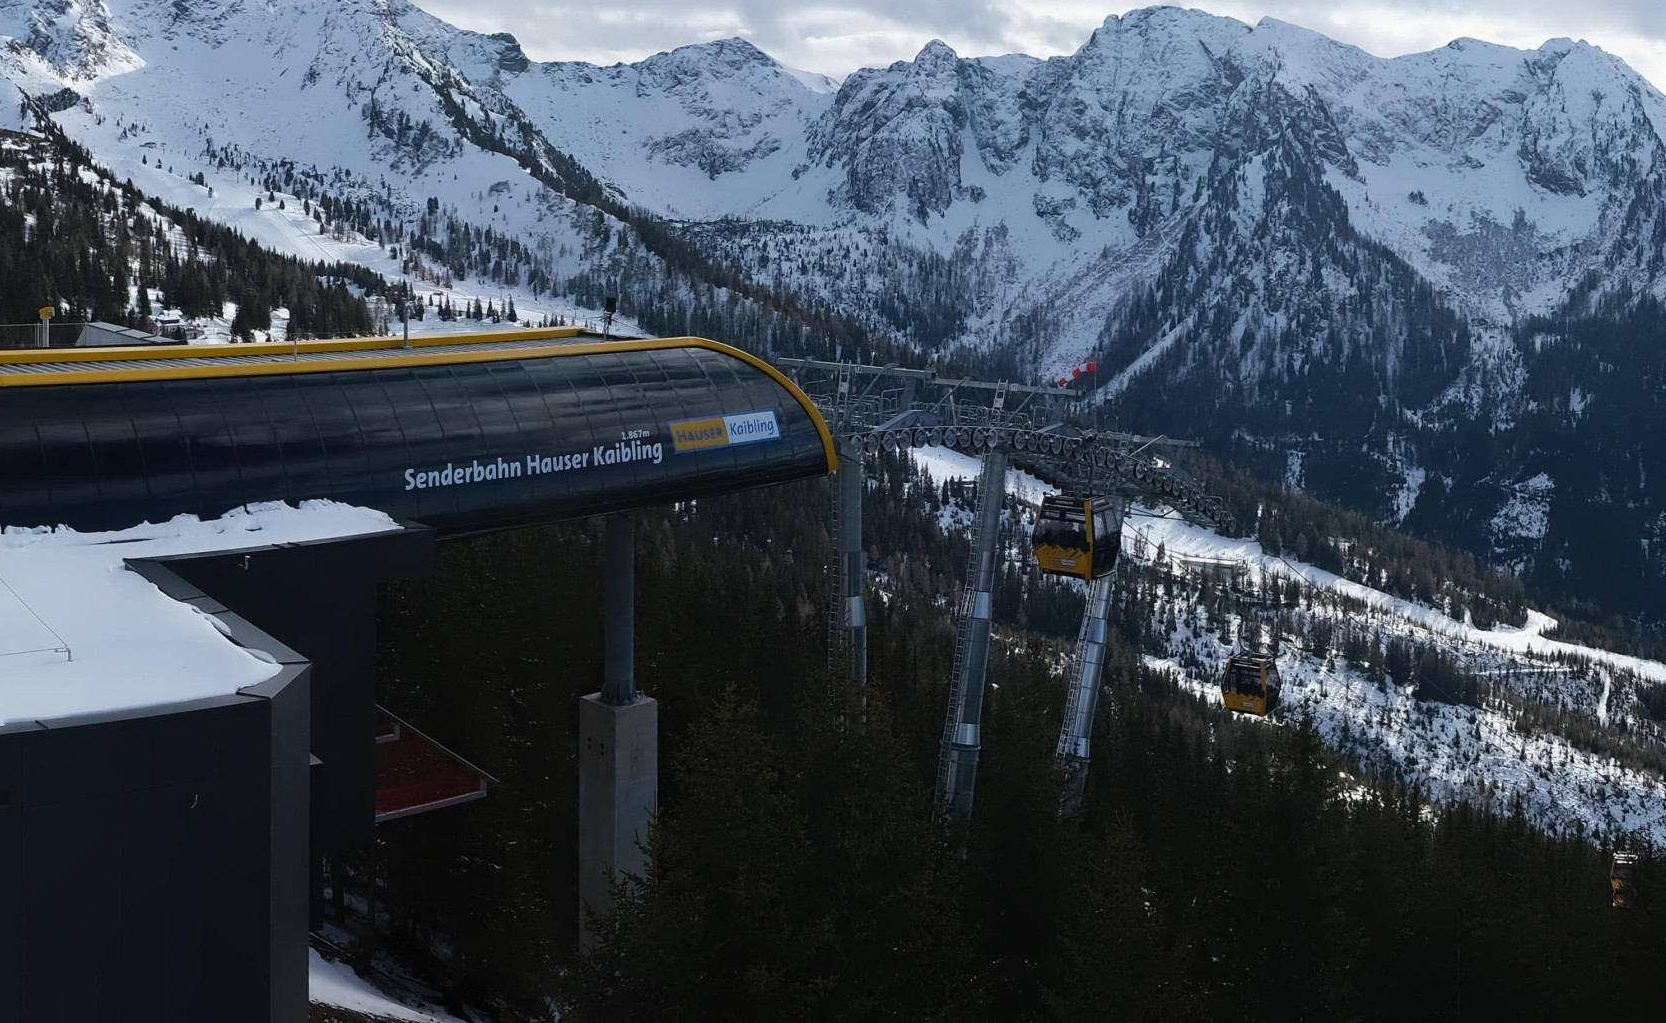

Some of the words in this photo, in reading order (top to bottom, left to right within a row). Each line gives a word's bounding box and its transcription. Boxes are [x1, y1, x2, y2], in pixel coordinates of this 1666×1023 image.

[621, 429, 650, 441] 1.867m
[677, 427, 723, 443] HAUSER
[730, 418, 775, 436] Kaibling
[404, 452, 521, 491] Senderbahn
[526, 450, 590, 476] Hauser
[593, 440, 663, 466] Kaibling
